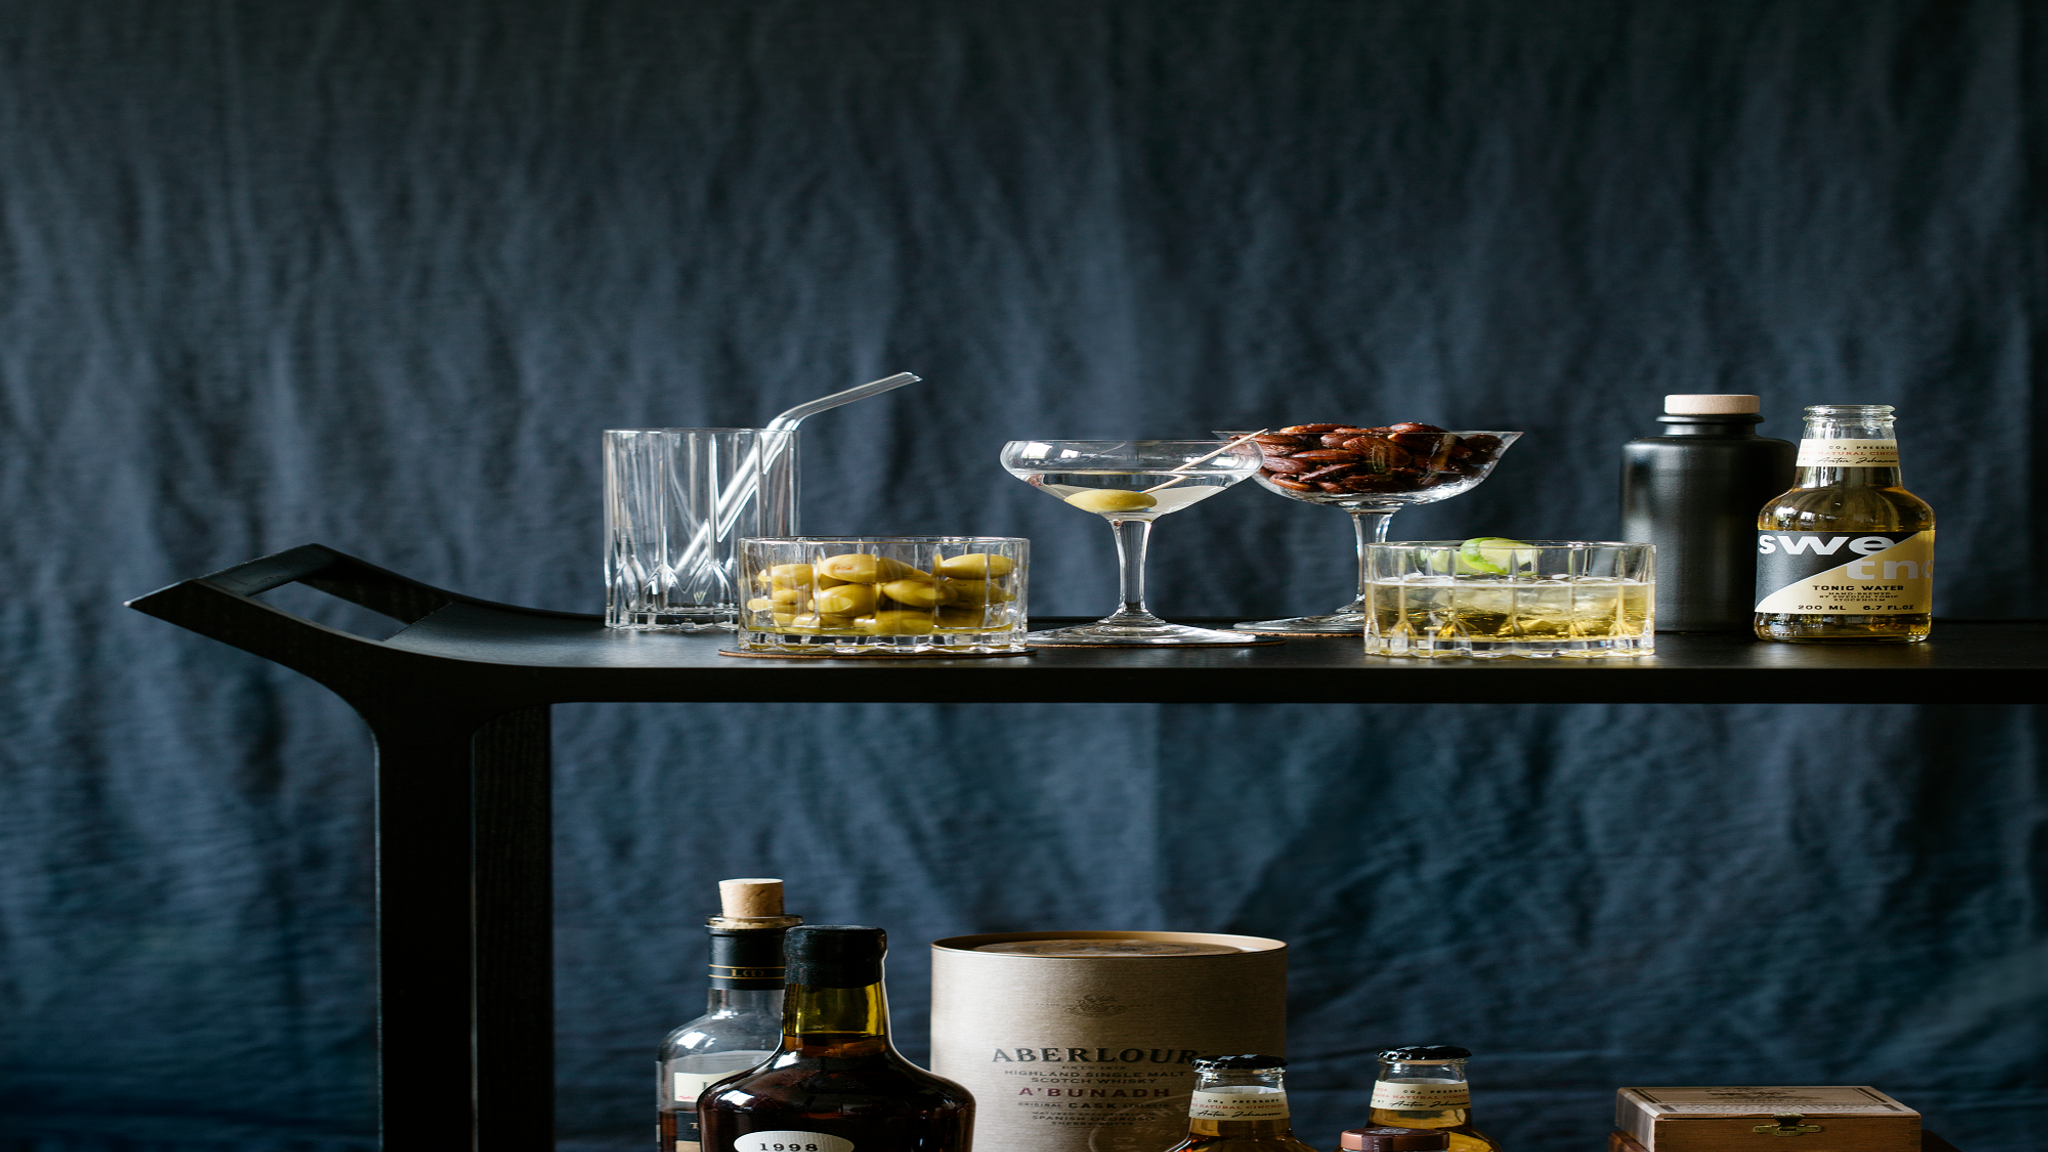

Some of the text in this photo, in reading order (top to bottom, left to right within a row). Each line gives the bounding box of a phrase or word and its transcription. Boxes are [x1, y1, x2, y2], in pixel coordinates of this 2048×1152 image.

[991, 1047, 1200, 1064] ABERLOUR
[1004, 1070, 1081, 1078] HIGHLAND
[1147, 1070, 1187, 1078] MALT
[759, 1143, 819, 1152] 1998
